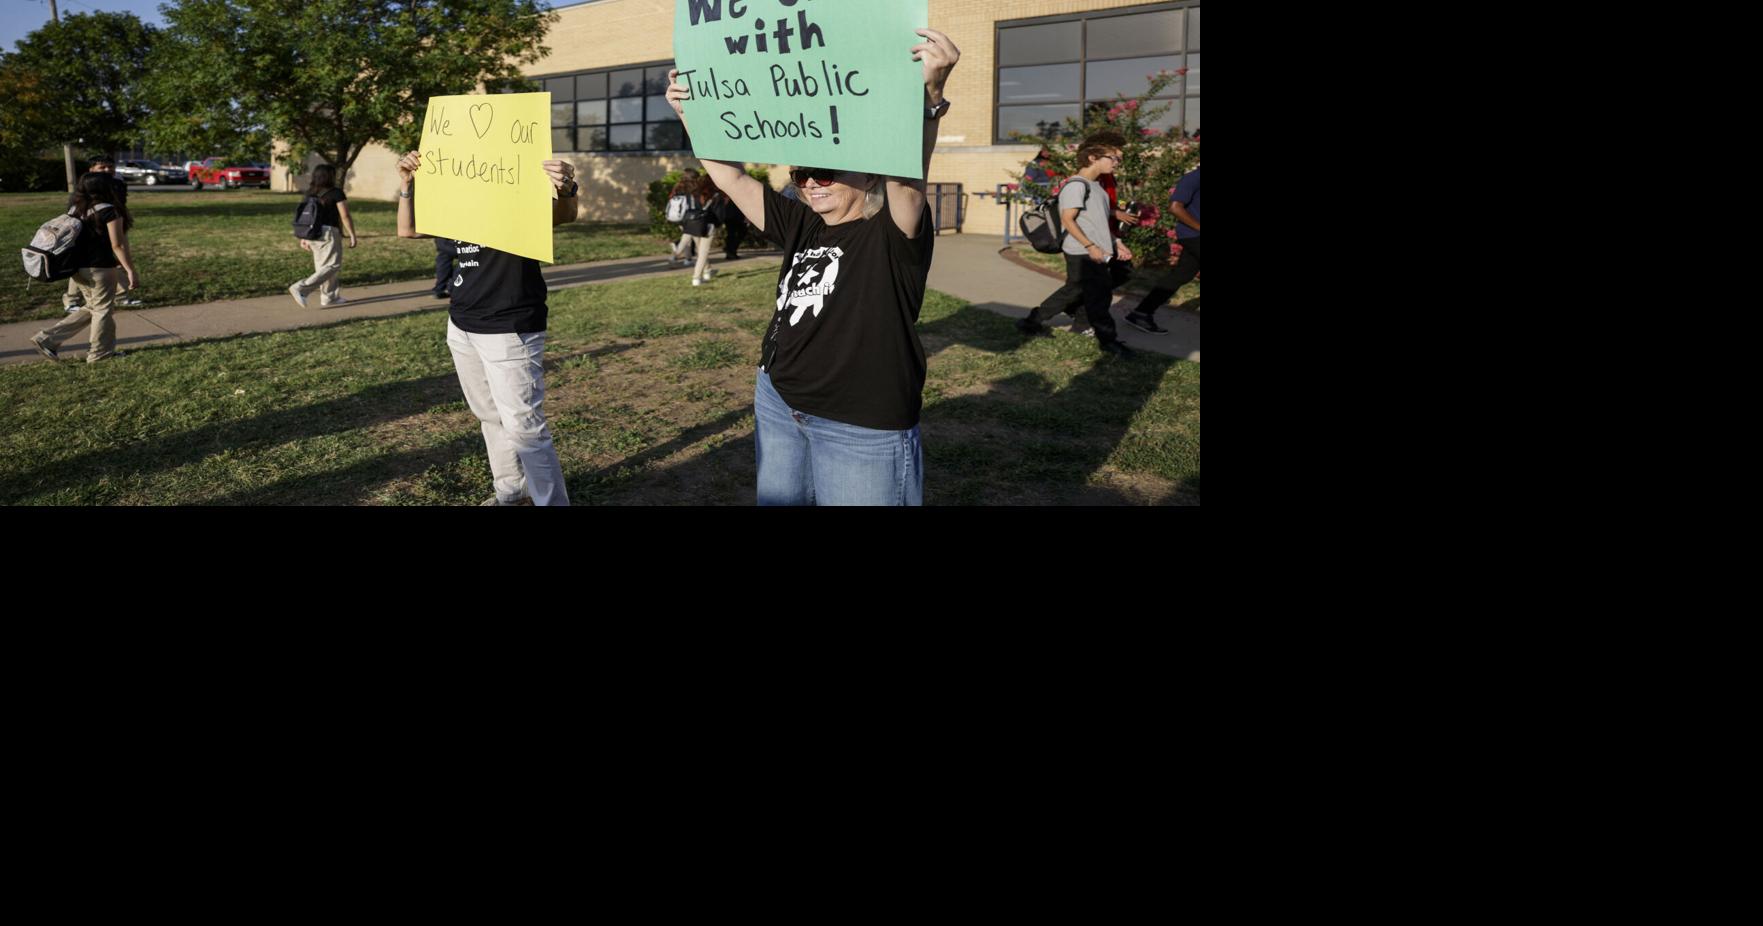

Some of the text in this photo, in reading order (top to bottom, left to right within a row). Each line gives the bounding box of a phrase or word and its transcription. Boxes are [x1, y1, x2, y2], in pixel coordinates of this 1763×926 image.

[688, 0, 748, 26] We
[724, 9, 826, 55] with
[677, 60, 869, 101] Tulsa Public
[430, 105, 453, 136] We
[720, 105, 840, 145] Schools!
